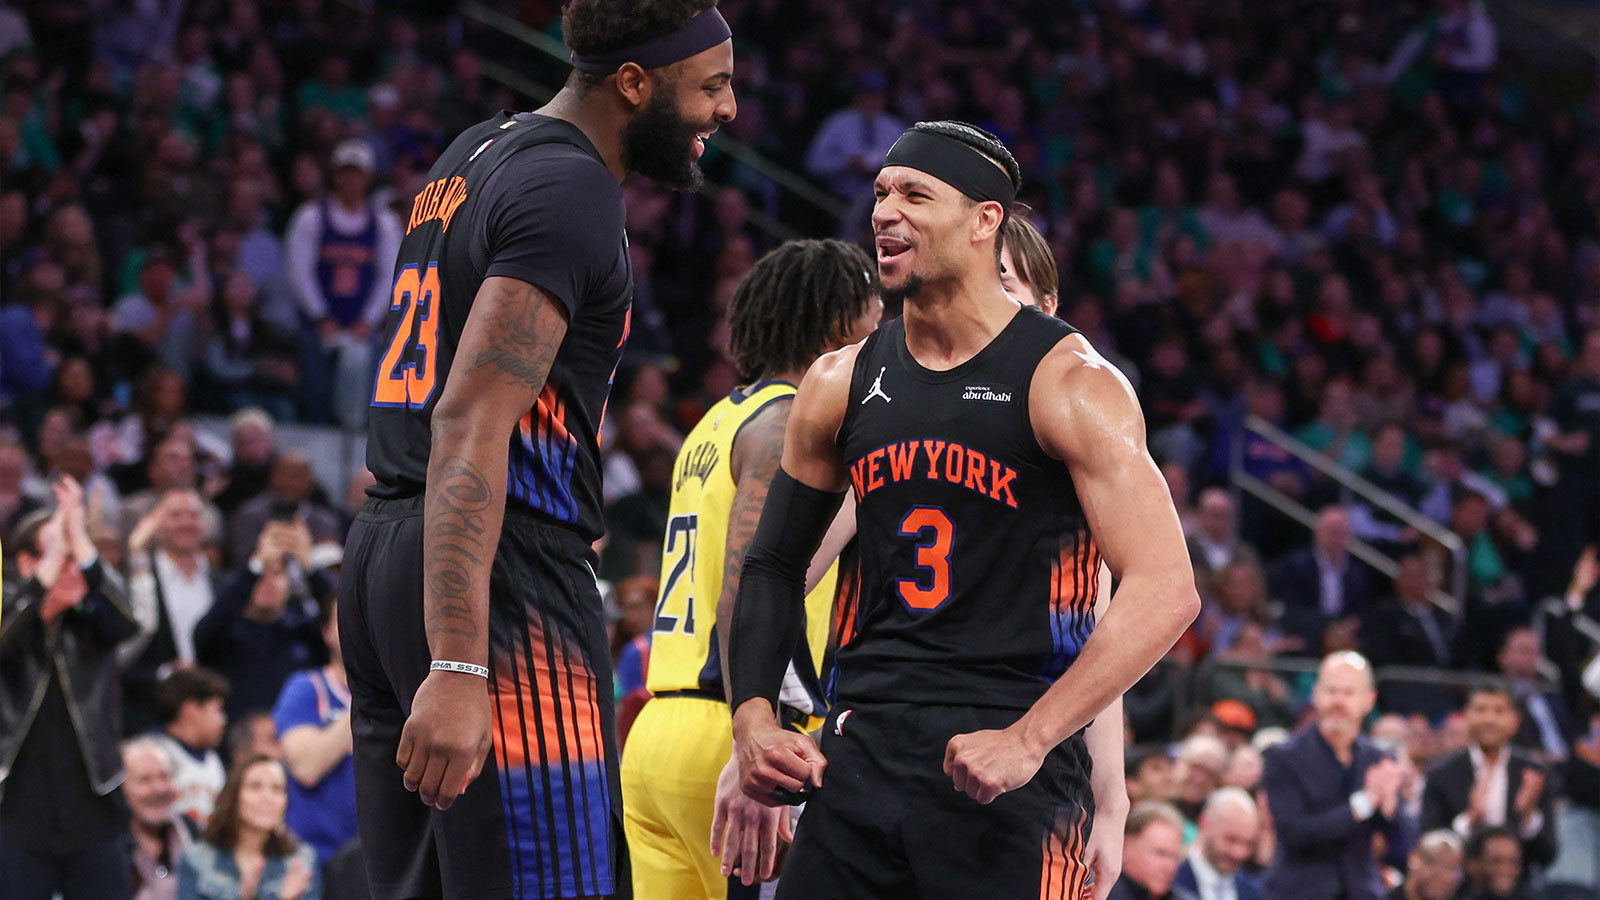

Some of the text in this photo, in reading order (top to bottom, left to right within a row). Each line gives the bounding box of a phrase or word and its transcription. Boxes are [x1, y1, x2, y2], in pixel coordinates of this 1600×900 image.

[370, 261, 441, 409] 23
[962, 391, 1012, 402] abu dhabi
[850, 439, 1019, 510] NEW YORK
[895, 504, 956, 613] 3
